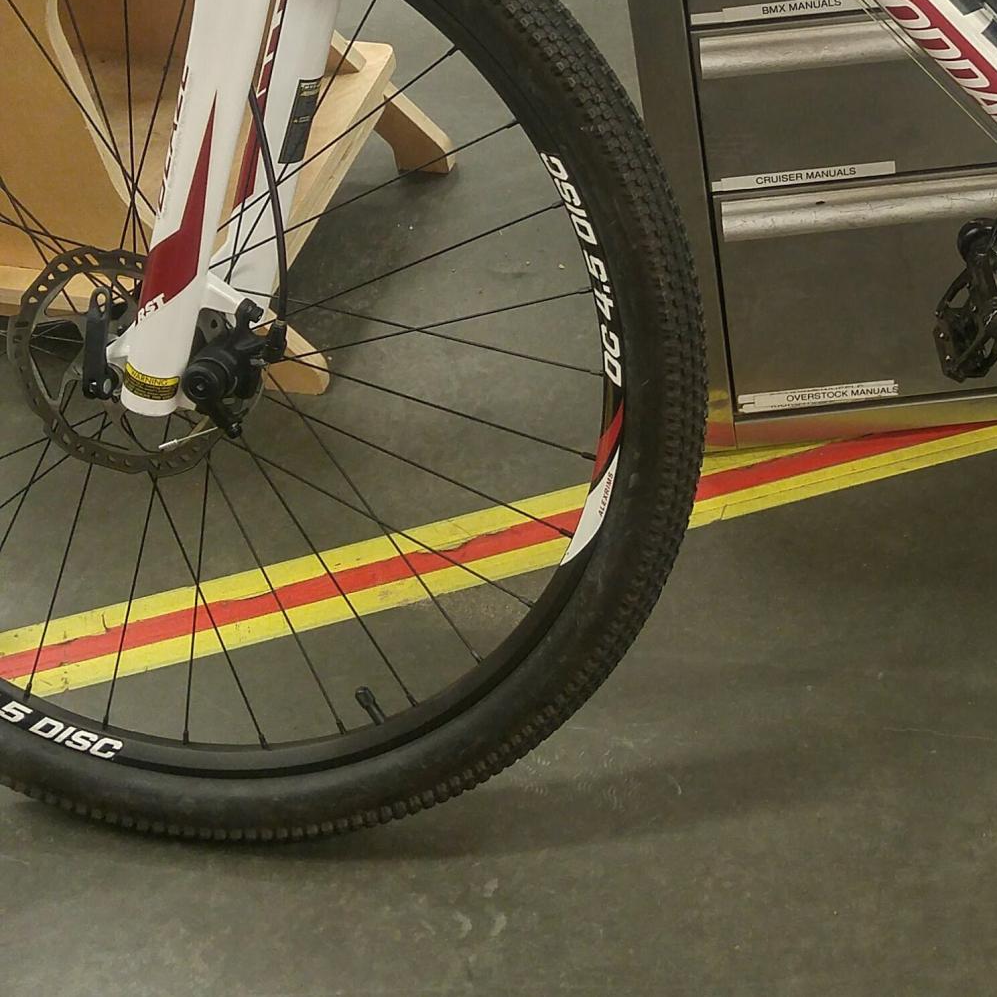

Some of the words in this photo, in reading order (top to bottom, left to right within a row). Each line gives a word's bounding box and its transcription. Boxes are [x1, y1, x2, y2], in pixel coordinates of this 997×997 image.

[762, 4, 786, 15] BMX
[755, 172, 803, 185] CRUISER
[805, 167, 857, 180] MANUALS
[540, 152, 598, 245] DISC
[583, 249, 614, 321] 4.5
[136, 292, 166, 325] RST
[786, 391, 848, 402] OVERSTOCK
[851, 386, 899, 397] MANUALS
[598, 471, 614, 517] ALEXRIMS
[28, 716, 124, 759] DISC
